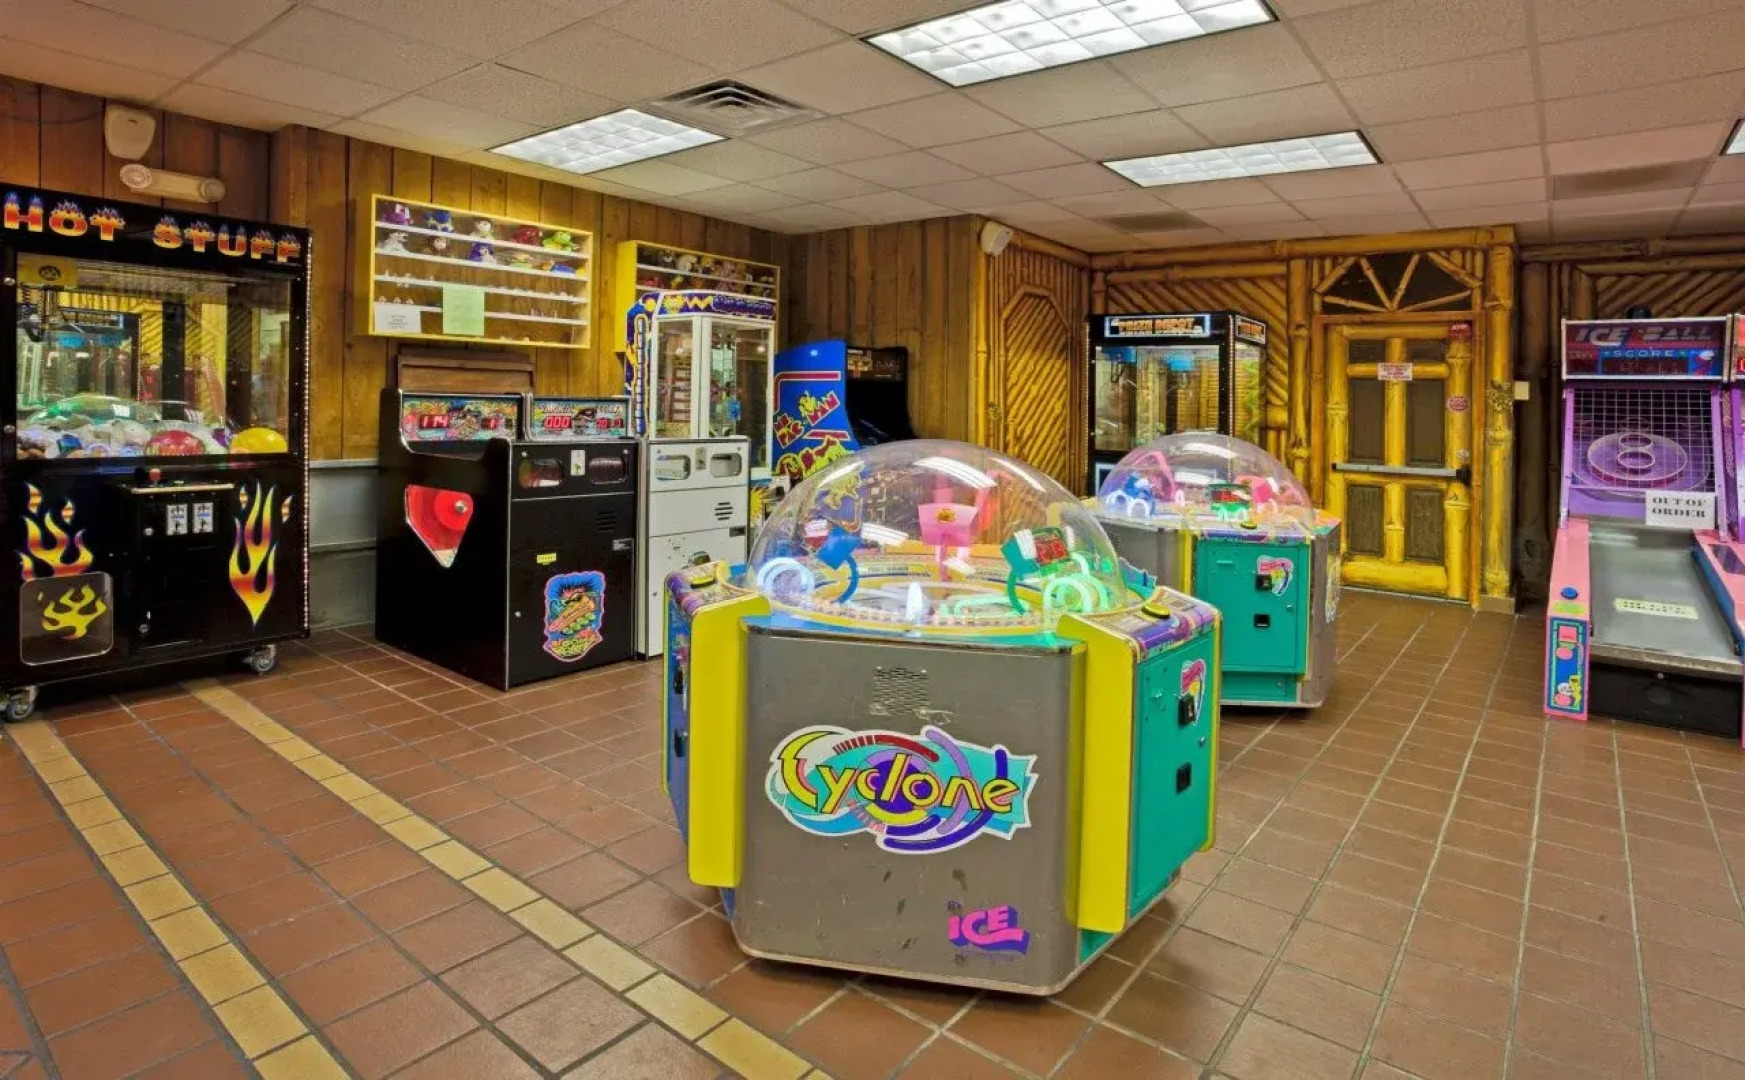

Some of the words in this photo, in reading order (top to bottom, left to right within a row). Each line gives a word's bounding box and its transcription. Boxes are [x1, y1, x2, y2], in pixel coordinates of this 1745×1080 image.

[4, 191, 126, 241] HOT
[153, 214, 301, 263] STUFF
[1117, 320, 1153, 332] PRIZE
[1155, 318, 1195, 332] DEPOT
[1575, 327, 1628, 346] ICE
[1642, 326, 1712, 341] BALL
[1614, 350, 1675, 358] SCORE
[1652, 497, 1683, 506] OUT
[1686, 498, 1707, 507] OF
[1652, 508, 1705, 518] ORDER
[779, 730, 1020, 815] Cyclone
[947, 904, 1030, 955] ICE
